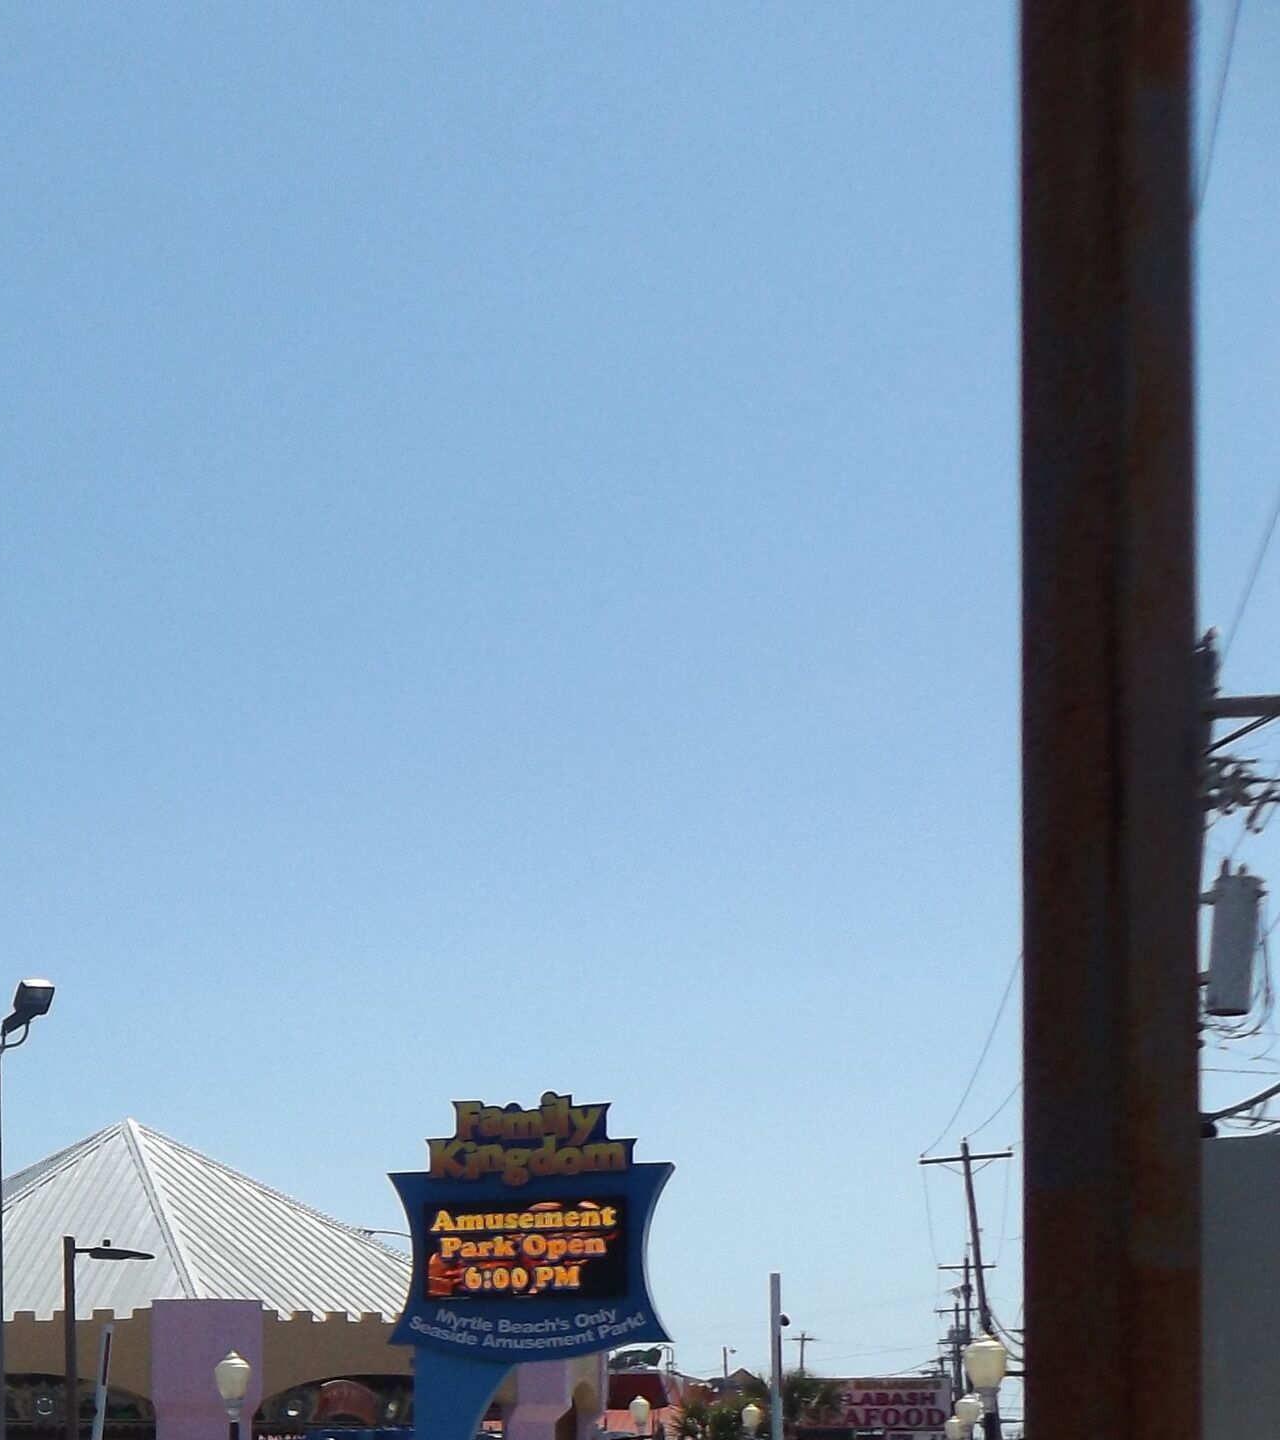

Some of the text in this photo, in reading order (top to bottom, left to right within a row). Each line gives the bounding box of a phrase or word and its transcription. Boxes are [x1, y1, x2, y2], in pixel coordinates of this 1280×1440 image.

[455, 1093, 602, 1146] Family
[430, 1135, 626, 1185] Kingdom
[430, 1207, 616, 1231] Amusement
[440, 1235, 607, 1259] Park Open
[465, 1266, 581, 1289] 6:00 PM
[409, 1312, 646, 1349] Seaside Amusement Park!
[435, 1308, 616, 1334] Myrtle Beach's Only
[842, 1392, 935, 1405] LABASH
[805, 1408, 945, 1426] SEAFOOD
